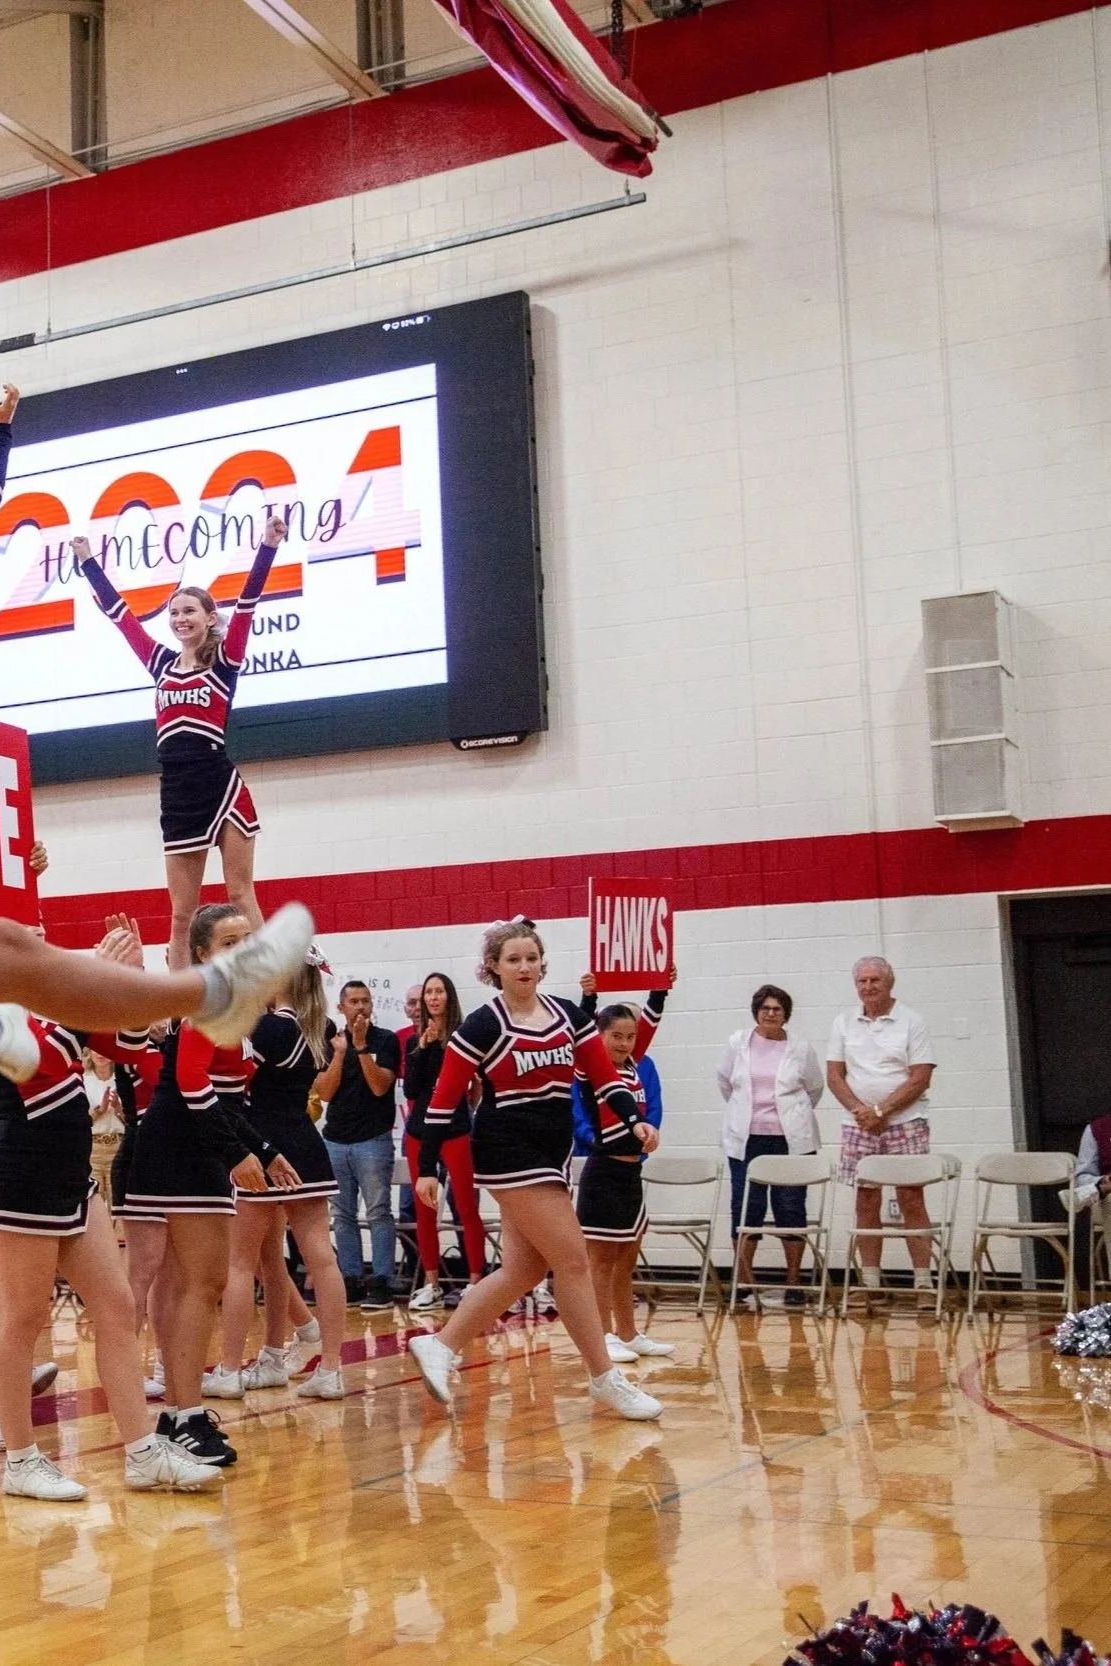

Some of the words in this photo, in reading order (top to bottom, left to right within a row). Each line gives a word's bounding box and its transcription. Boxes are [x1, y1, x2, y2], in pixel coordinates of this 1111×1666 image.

[251, 613, 300, 635] UND
[241, 649, 303, 675] NKA
[158, 685, 211, 712] MWHS
[595, 896, 668, 974] HAWKS
[511, 1042, 574, 1077] MWHS
